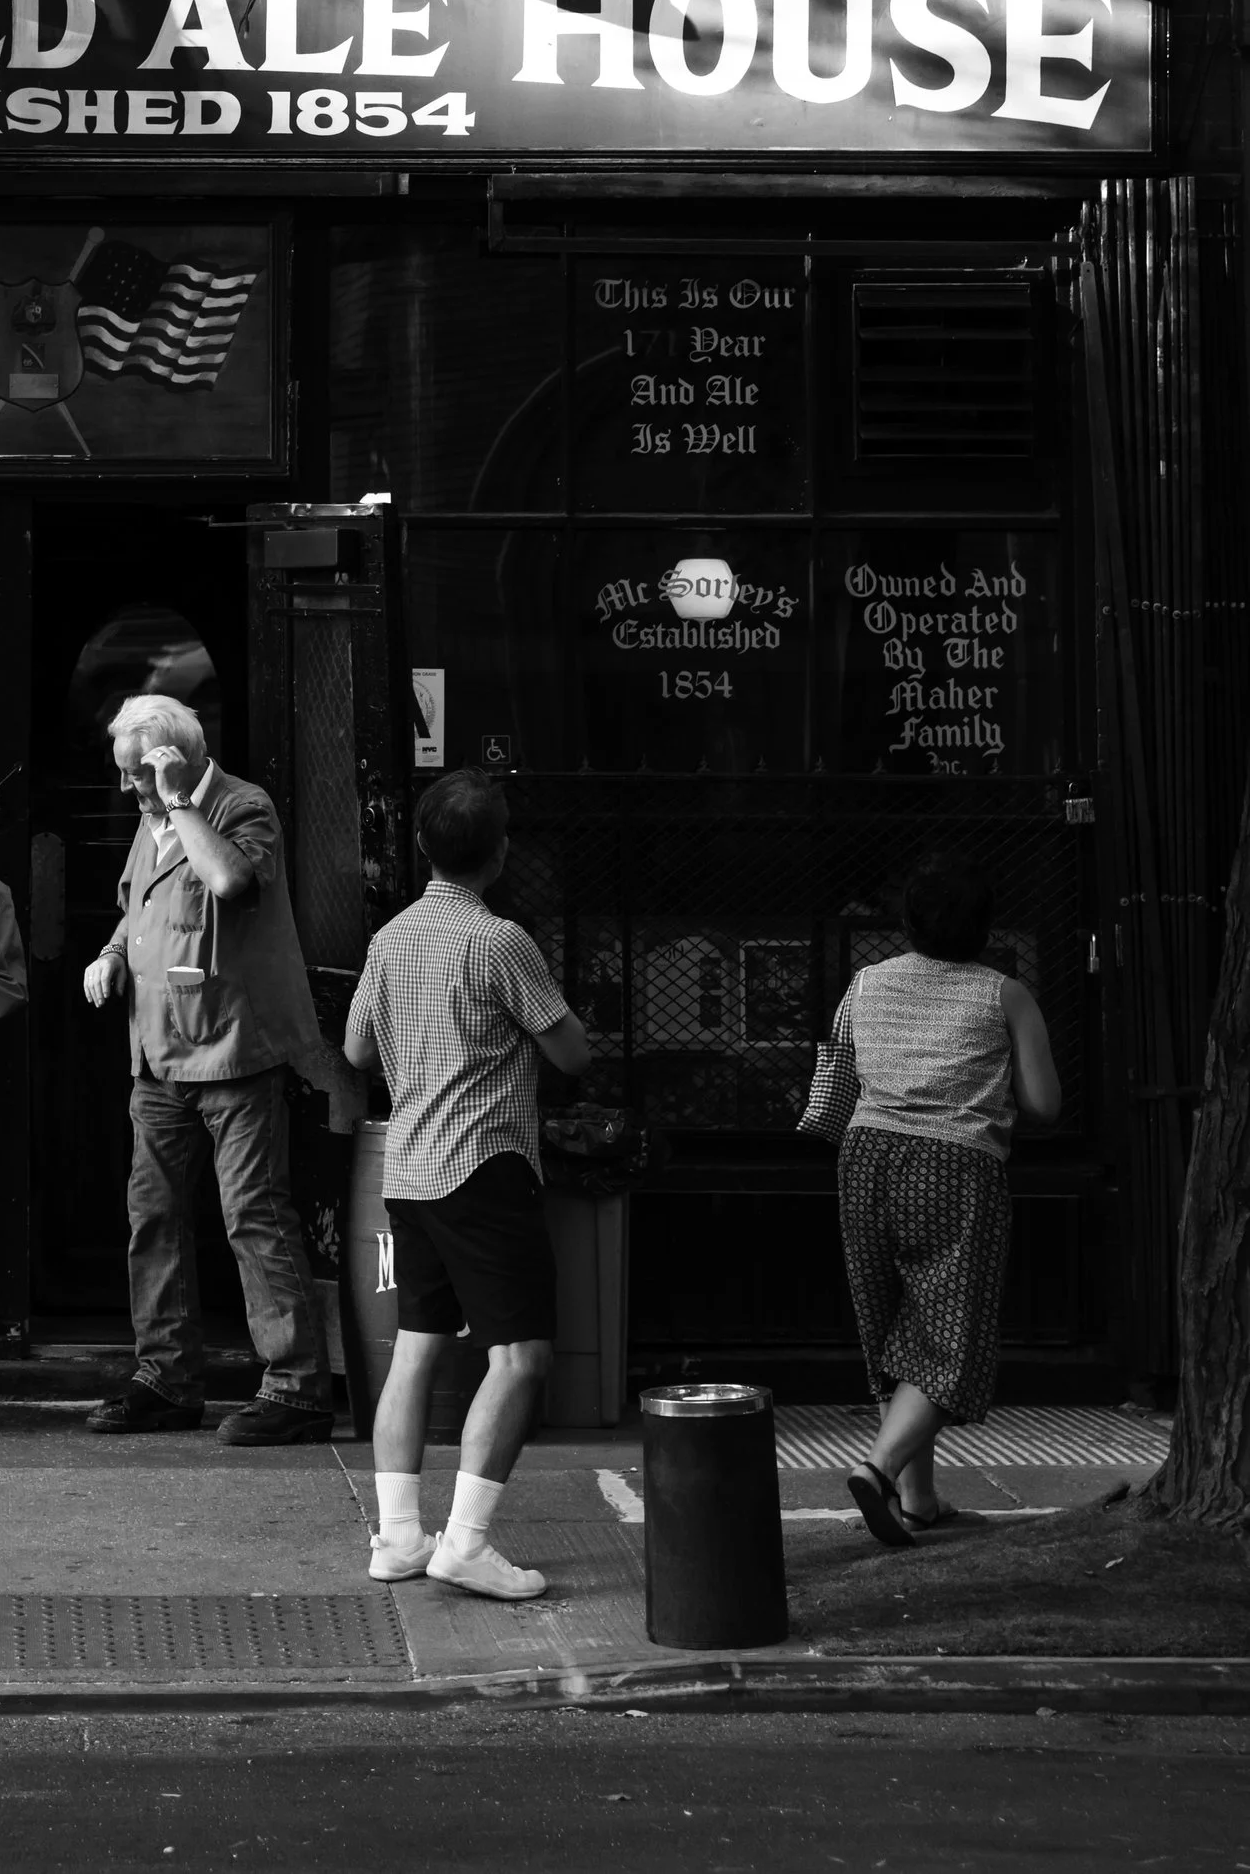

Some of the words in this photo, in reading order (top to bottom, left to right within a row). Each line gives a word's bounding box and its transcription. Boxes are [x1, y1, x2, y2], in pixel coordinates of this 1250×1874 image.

[267, 89, 476, 137] 1854
[593, 278, 668, 314] This
[678, 278, 719, 309] Is
[729, 278, 796, 309] Our
[689, 326, 766, 363] Year
[631, 374, 695, 406] And
[705, 374, 761, 406] Ale
[631, 423, 672, 454] Is
[682, 423, 757, 454] Well
[595, 578, 651, 624] Mc
[657, 569, 799, 618] Sorley's
[844, 560, 956, 598] Owned
[964, 559, 1026, 598] And
[612, 619, 781, 655] Established
[863, 599, 1017, 642] Operated
[883, 637, 926, 680] By
[942, 637, 1005, 669] The
[658, 670, 733, 699] 1854
[884, 678, 998, 716] Maher
[888, 713, 1006, 758] Family
